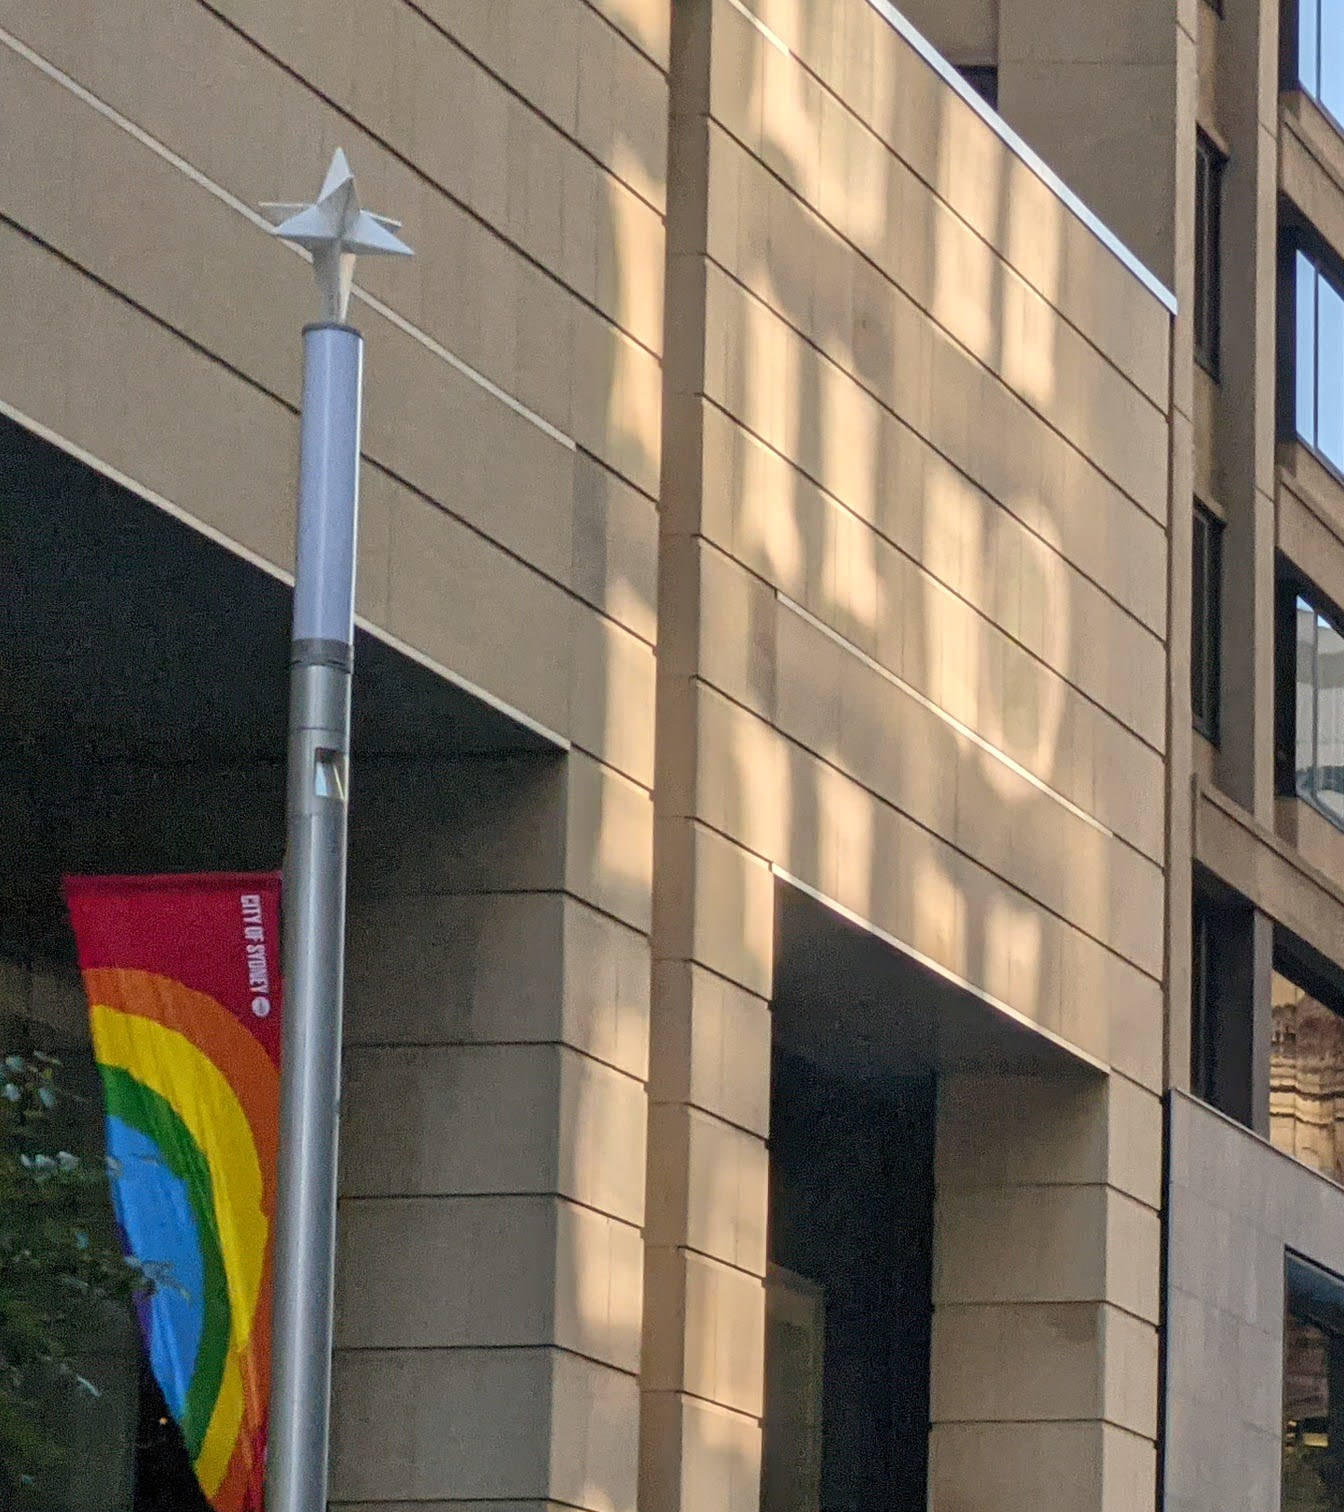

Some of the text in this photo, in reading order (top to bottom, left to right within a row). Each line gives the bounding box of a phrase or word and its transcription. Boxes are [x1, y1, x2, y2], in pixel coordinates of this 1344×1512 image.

[240, 894, 270, 995] CITY OF SYDNEY
